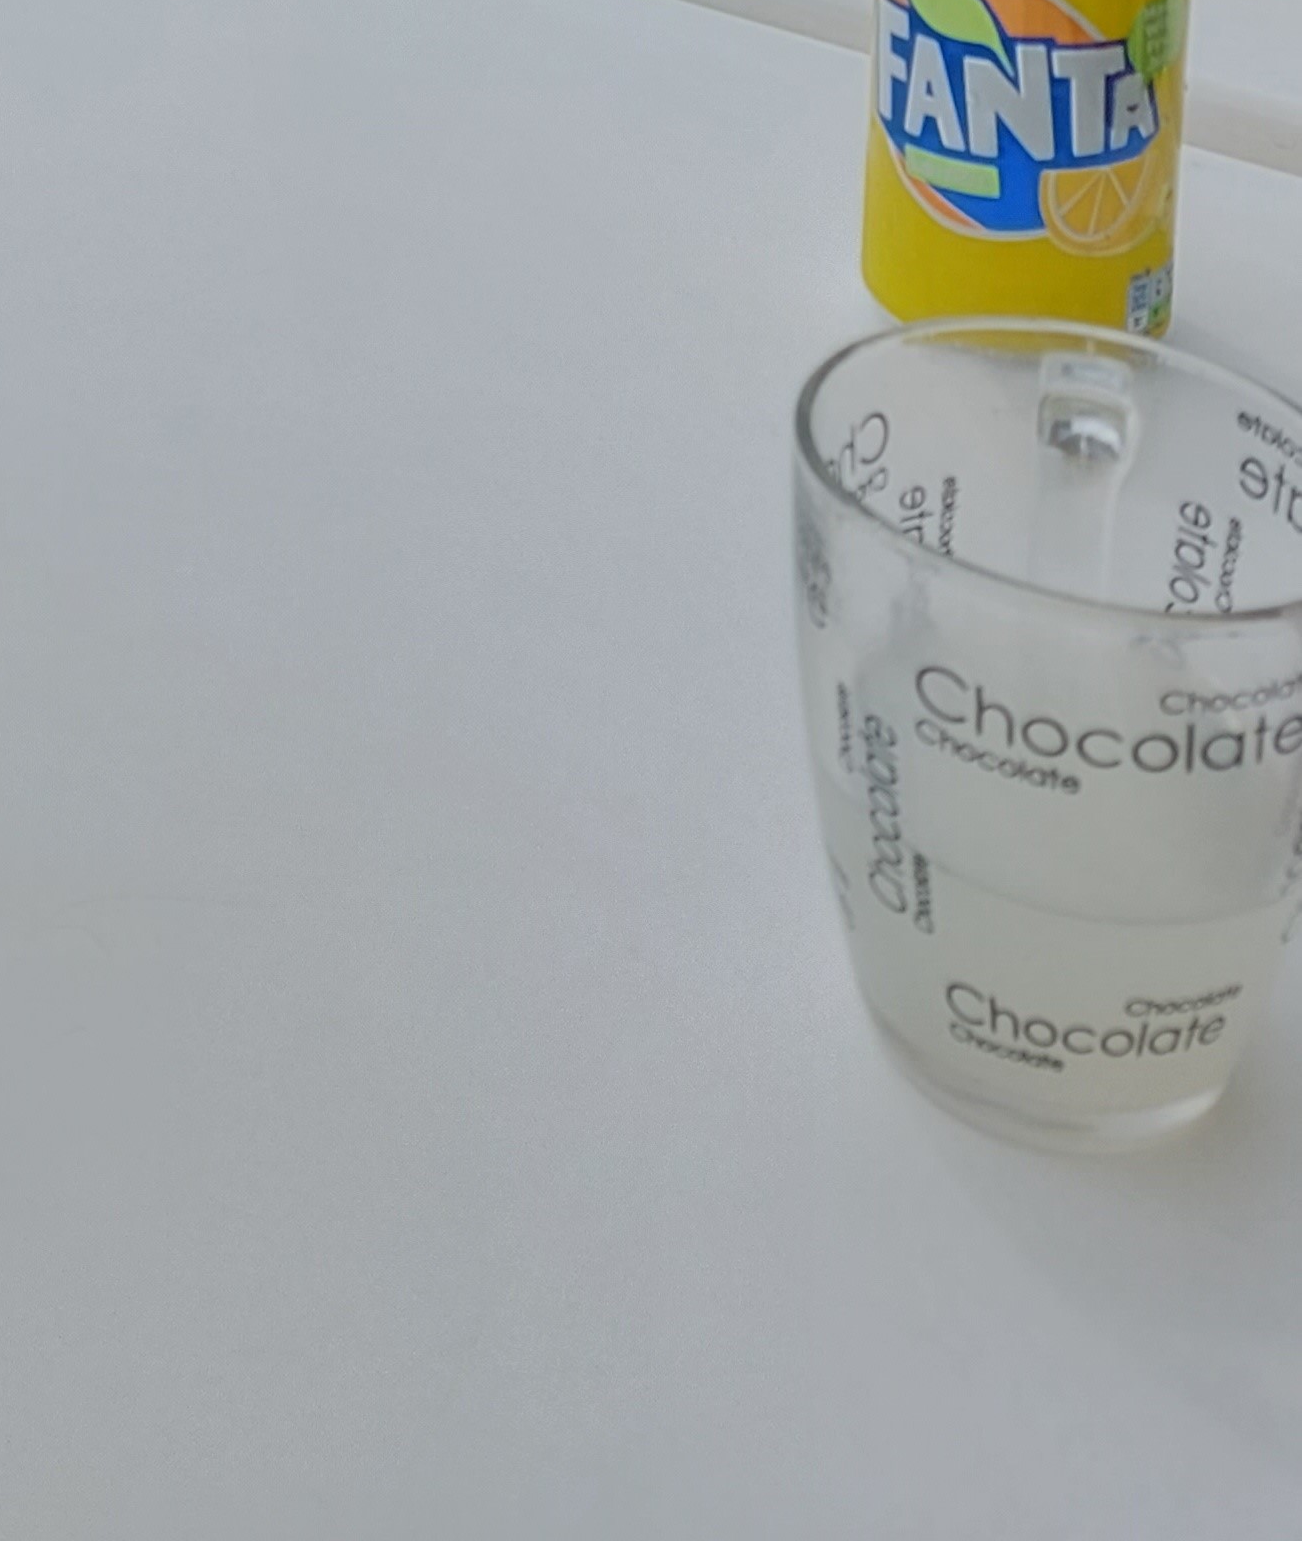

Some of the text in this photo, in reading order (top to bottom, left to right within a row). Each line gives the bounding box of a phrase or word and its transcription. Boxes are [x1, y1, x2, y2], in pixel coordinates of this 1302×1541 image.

[915, 665, 1302, 774] Chocolate
[915, 719, 1081, 795] Chocolate
[947, 982, 1225, 1058] Chocolate
